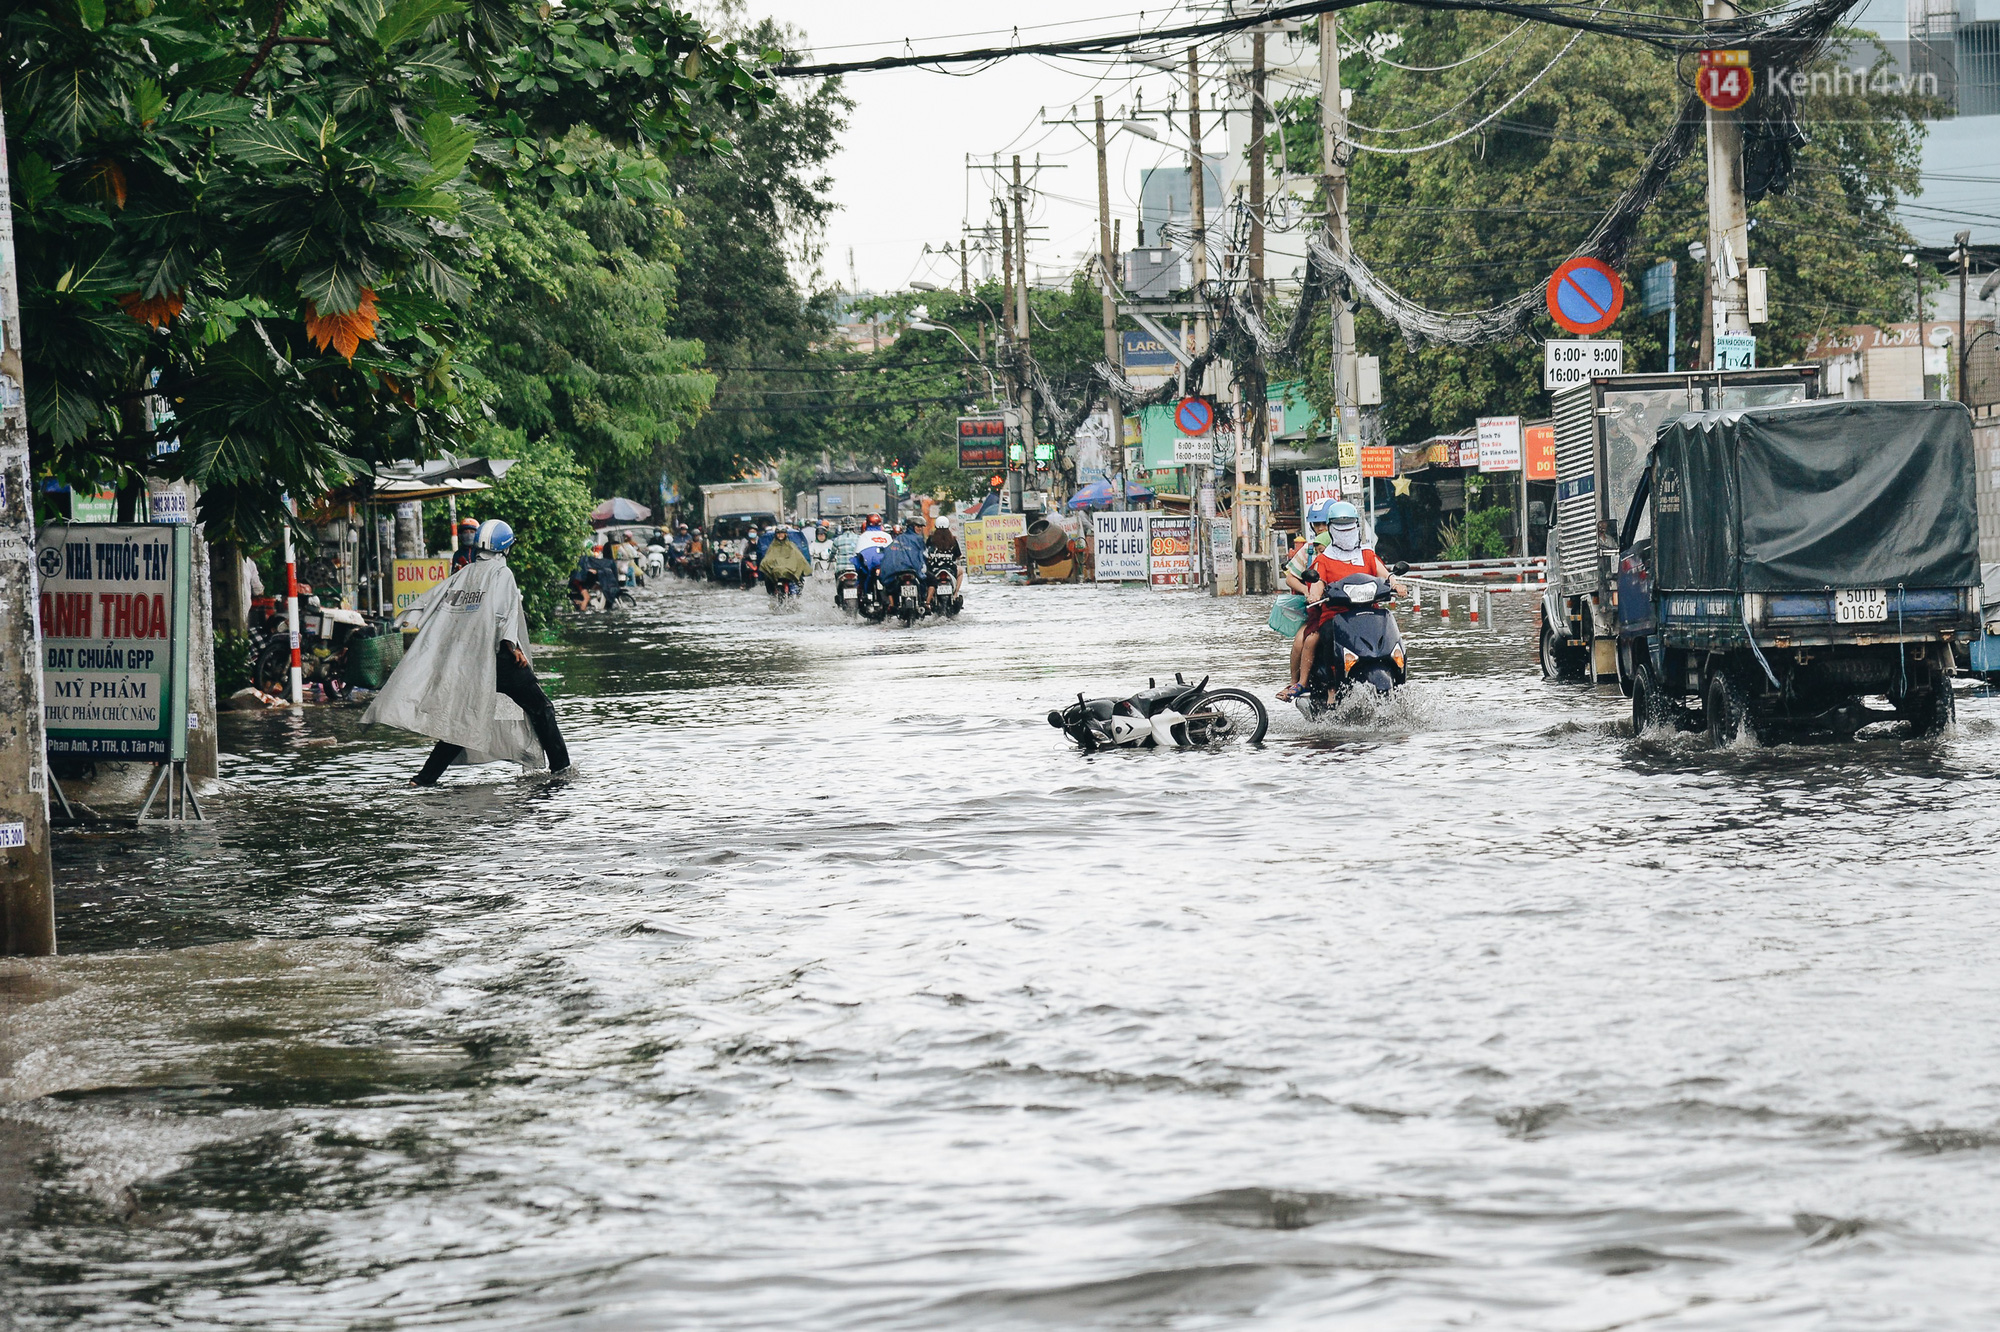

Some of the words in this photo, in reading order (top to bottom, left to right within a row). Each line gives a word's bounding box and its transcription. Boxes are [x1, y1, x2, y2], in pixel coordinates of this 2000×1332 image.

[1593, 348, 1618, 362] 9:00
[961, 420, 1004, 436] GYM
[1097, 517, 1117, 533] THU
[1121, 517, 1144, 533] MUA
[1098, 533, 1119, 554] PHẾ
[1122, 535, 1143, 557] LIỆU
[1152, 538, 1176, 555] 99
[66, 537, 92, 580] NHÀ
[96, 536, 139, 581] THUỐC
[143, 538, 168, 581] TÂY
[987, 552, 1007, 563] 25K
[397, 563, 424, 581] BÚN
[428, 562, 446, 581] CÁ
[40, 591, 92, 639] ANH
[99, 592, 167, 640] THOA
[1843, 605, 1882, 620] 016.62
[48, 648, 74, 672] ĐẠT
[77, 641, 123, 669] CHUẨN
[127, 649, 154, 669] GPP
[55, 678, 84, 698] MỸ
[90, 675, 147, 698] PHẨM
[44, 705, 70, 722] THỰC
[72, 701, 100, 720] PHẨM
[102, 703, 128, 720] CHỨC
[130, 705, 156, 721] NĂNG
[48, 740, 69, 751] Phan
[71, 740, 90, 752] Anh,
[92, 741, 99, 751] P.
[101, 741, 119, 752] TTH,
[121, 742, 129, 752] Q.
[131, 741, 147, 752] Tân
[148, 742, 165, 752] Phú
